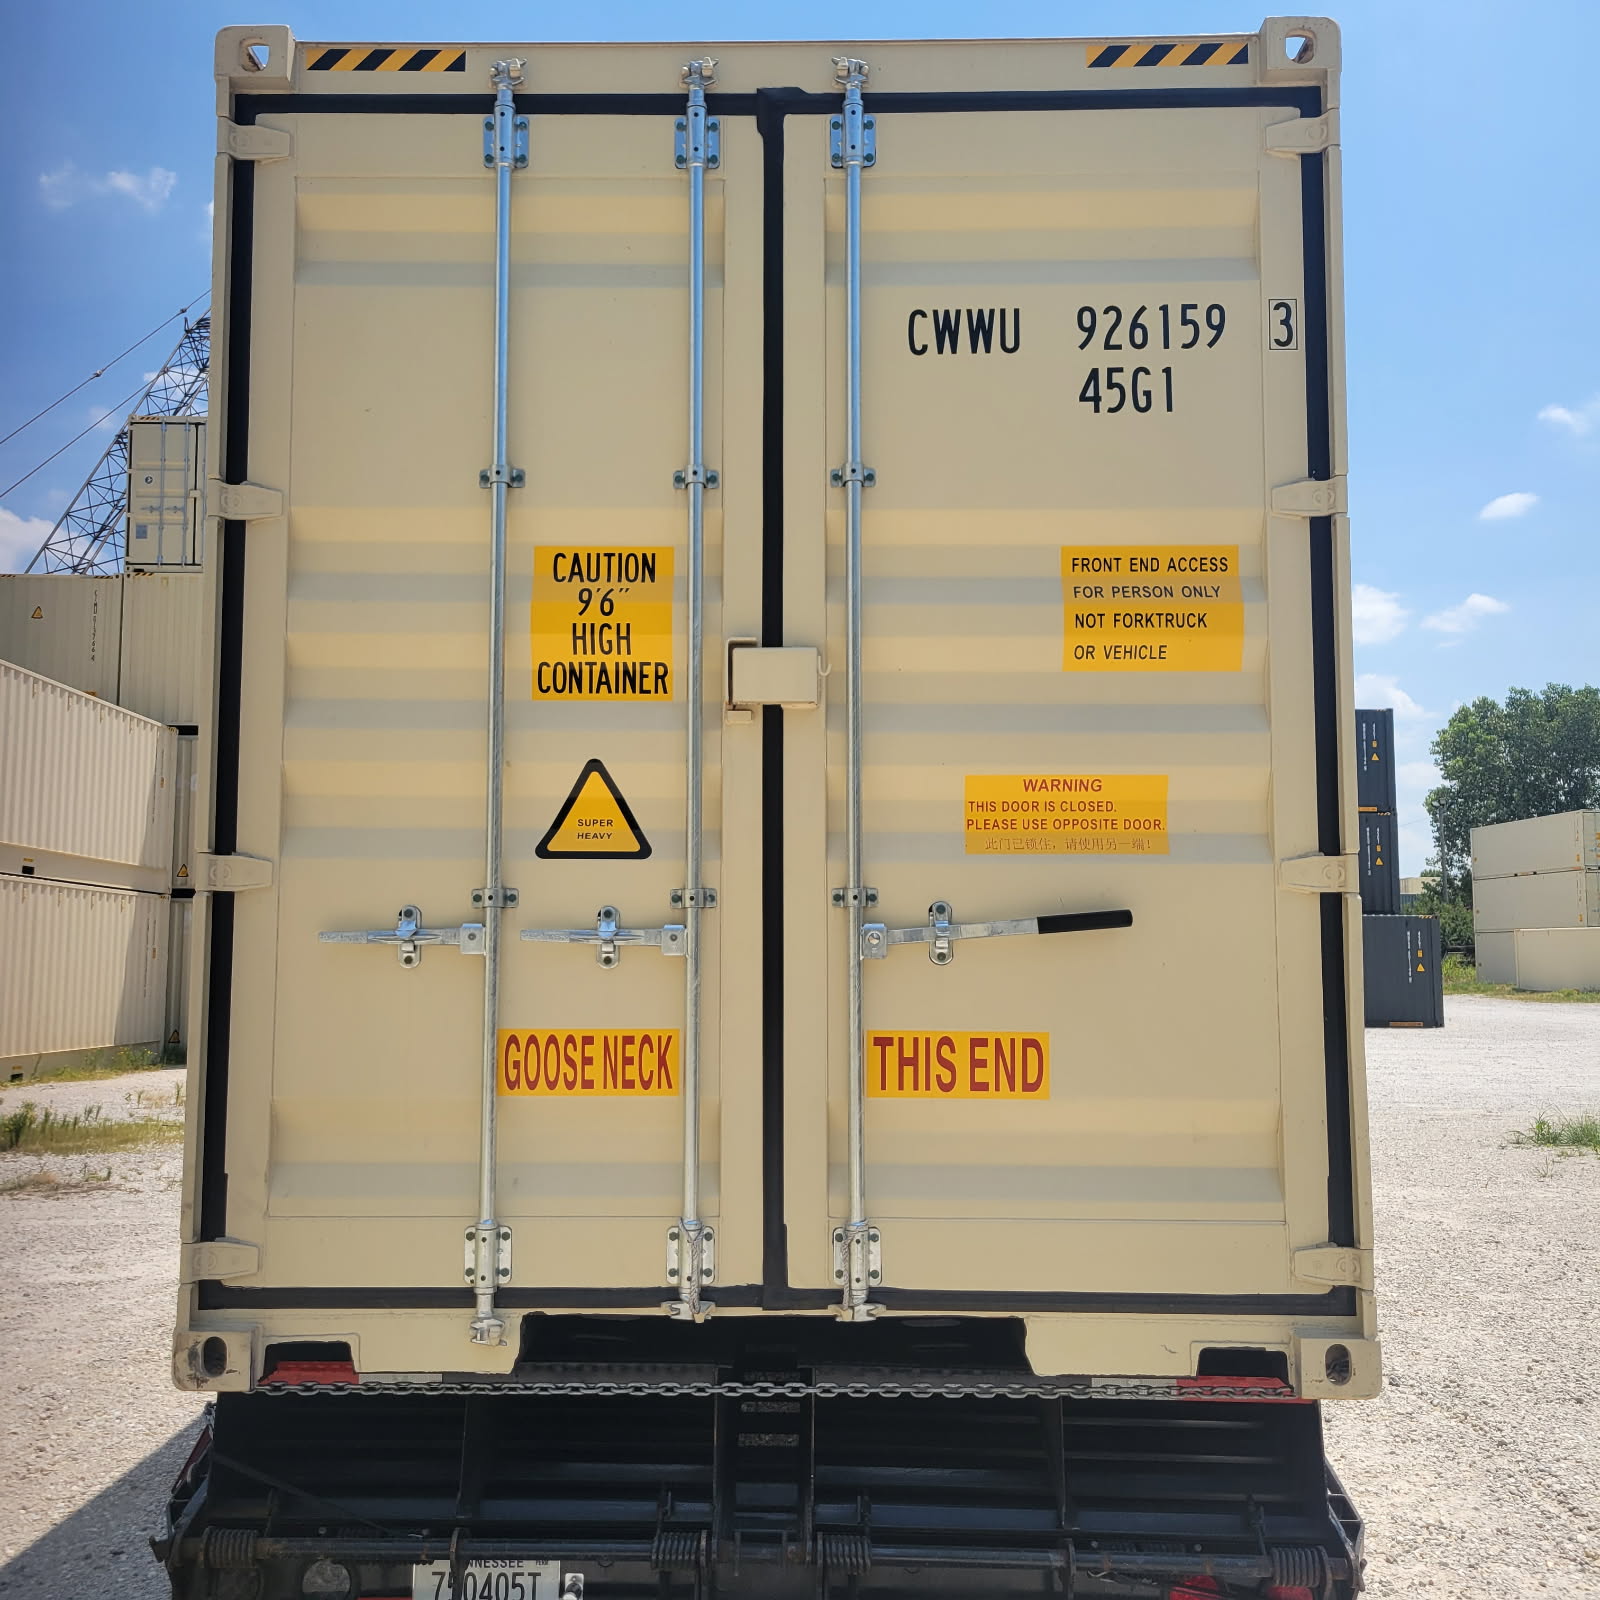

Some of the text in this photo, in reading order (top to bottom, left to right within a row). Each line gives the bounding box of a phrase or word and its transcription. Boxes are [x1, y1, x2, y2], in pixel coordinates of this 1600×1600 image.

[907, 302, 1293, 356] CWWU 926159 3
[1078, 366, 1173, 413] 45G1
[553, 552, 656, 583] CAUTION
[1072, 557, 1229, 572] FRONT END ACCESS
[1073, 586, 1221, 598] FOR PERSON ONLY
[1075, 612, 1208, 629] NOT FORKTRUCK
[572, 623, 632, 655] HIGH
[1074, 645, 1168, 660] OR VEHICLE
[537, 661, 669, 695] CONTAINER
[1023, 778, 1103, 793] WARNING
[968, 801, 1117, 813] THIS DOOR IS CLOSED.
[577, 819, 614, 827] SUPER
[966, 818, 1165, 831] PLEASE USE OPPOSITE DOOR.
[577, 832, 613, 840] HEAVY
[504, 1033, 673, 1091] GOOSE NECK
[872, 1035, 1044, 1093] THIS END
